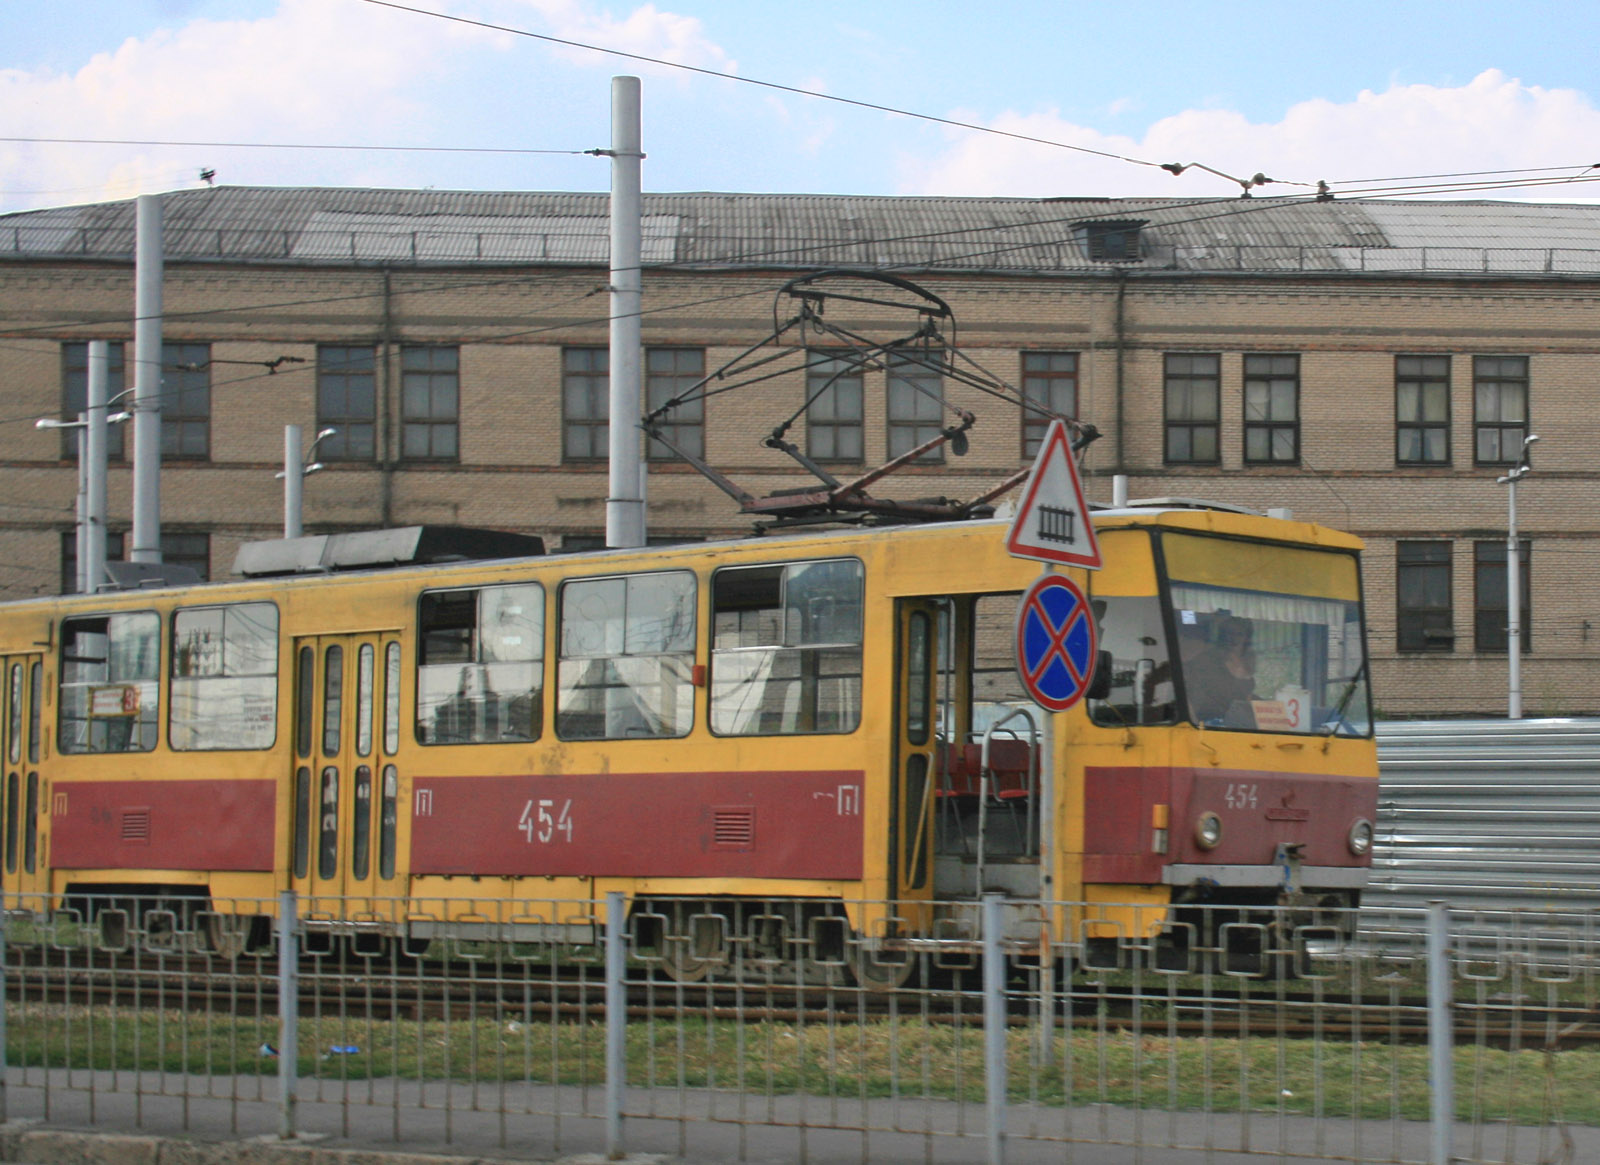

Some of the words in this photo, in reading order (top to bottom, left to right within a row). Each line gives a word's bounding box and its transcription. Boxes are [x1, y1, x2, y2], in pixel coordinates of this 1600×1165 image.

[125, 688, 134, 710] 3
[1288, 698, 1299, 728] 3
[1225, 784, 1258, 809] 454
[518, 799, 572, 843] 454
